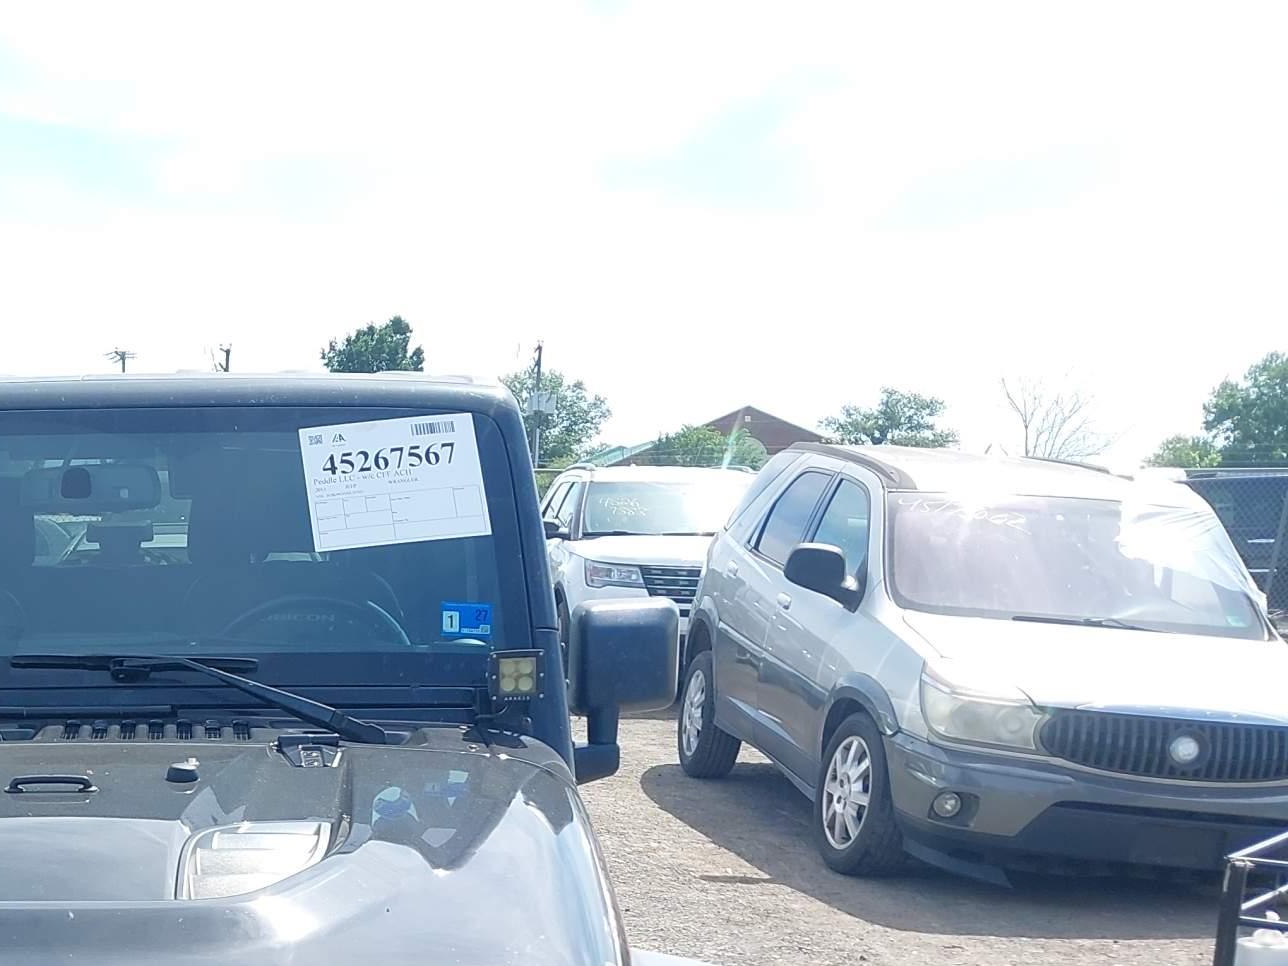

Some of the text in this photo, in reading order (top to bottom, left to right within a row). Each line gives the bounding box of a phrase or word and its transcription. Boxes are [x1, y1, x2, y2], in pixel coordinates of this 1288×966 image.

[322, 442, 455, 475] 45267567
[313, 477, 337, 486] Peddle
[339, 475, 354, 483] LLC
[447, 614, 454, 629] 1
[475, 609, 489, 621] 27
